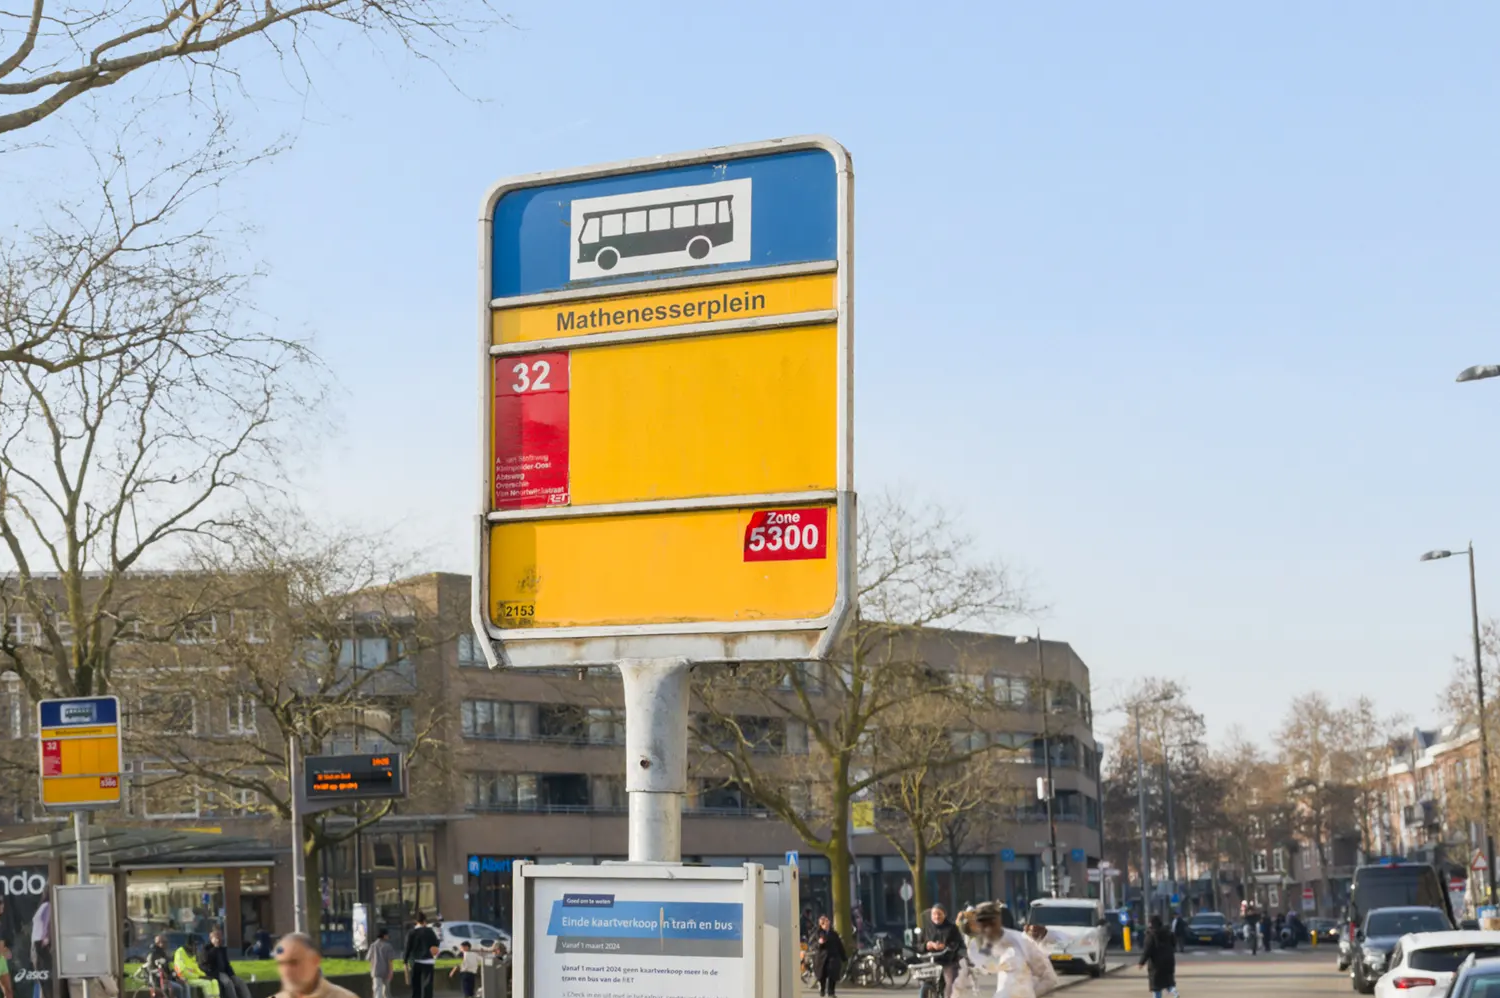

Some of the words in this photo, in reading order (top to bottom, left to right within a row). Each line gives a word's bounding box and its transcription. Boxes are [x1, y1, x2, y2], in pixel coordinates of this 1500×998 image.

[556, 291, 766, 332] Mathenesserplein
[512, 360, 551, 393] 32
[766, 512, 800, 525] Zone
[748, 524, 819, 551] 5300
[506, 604, 535, 617] 2153
[46, 742, 57, 750] 32
[562, 917, 589, 927] Einde
[592, 917, 658, 931] kaartverkoop
[672, 919, 696, 929] tram
[699, 922, 712, 930] en
[714, 919, 733, 930] bus
[605, 942, 620, 950] 2024
[26, 970, 49, 980] asics
[640, 967, 683, 976] kaartverkoop
